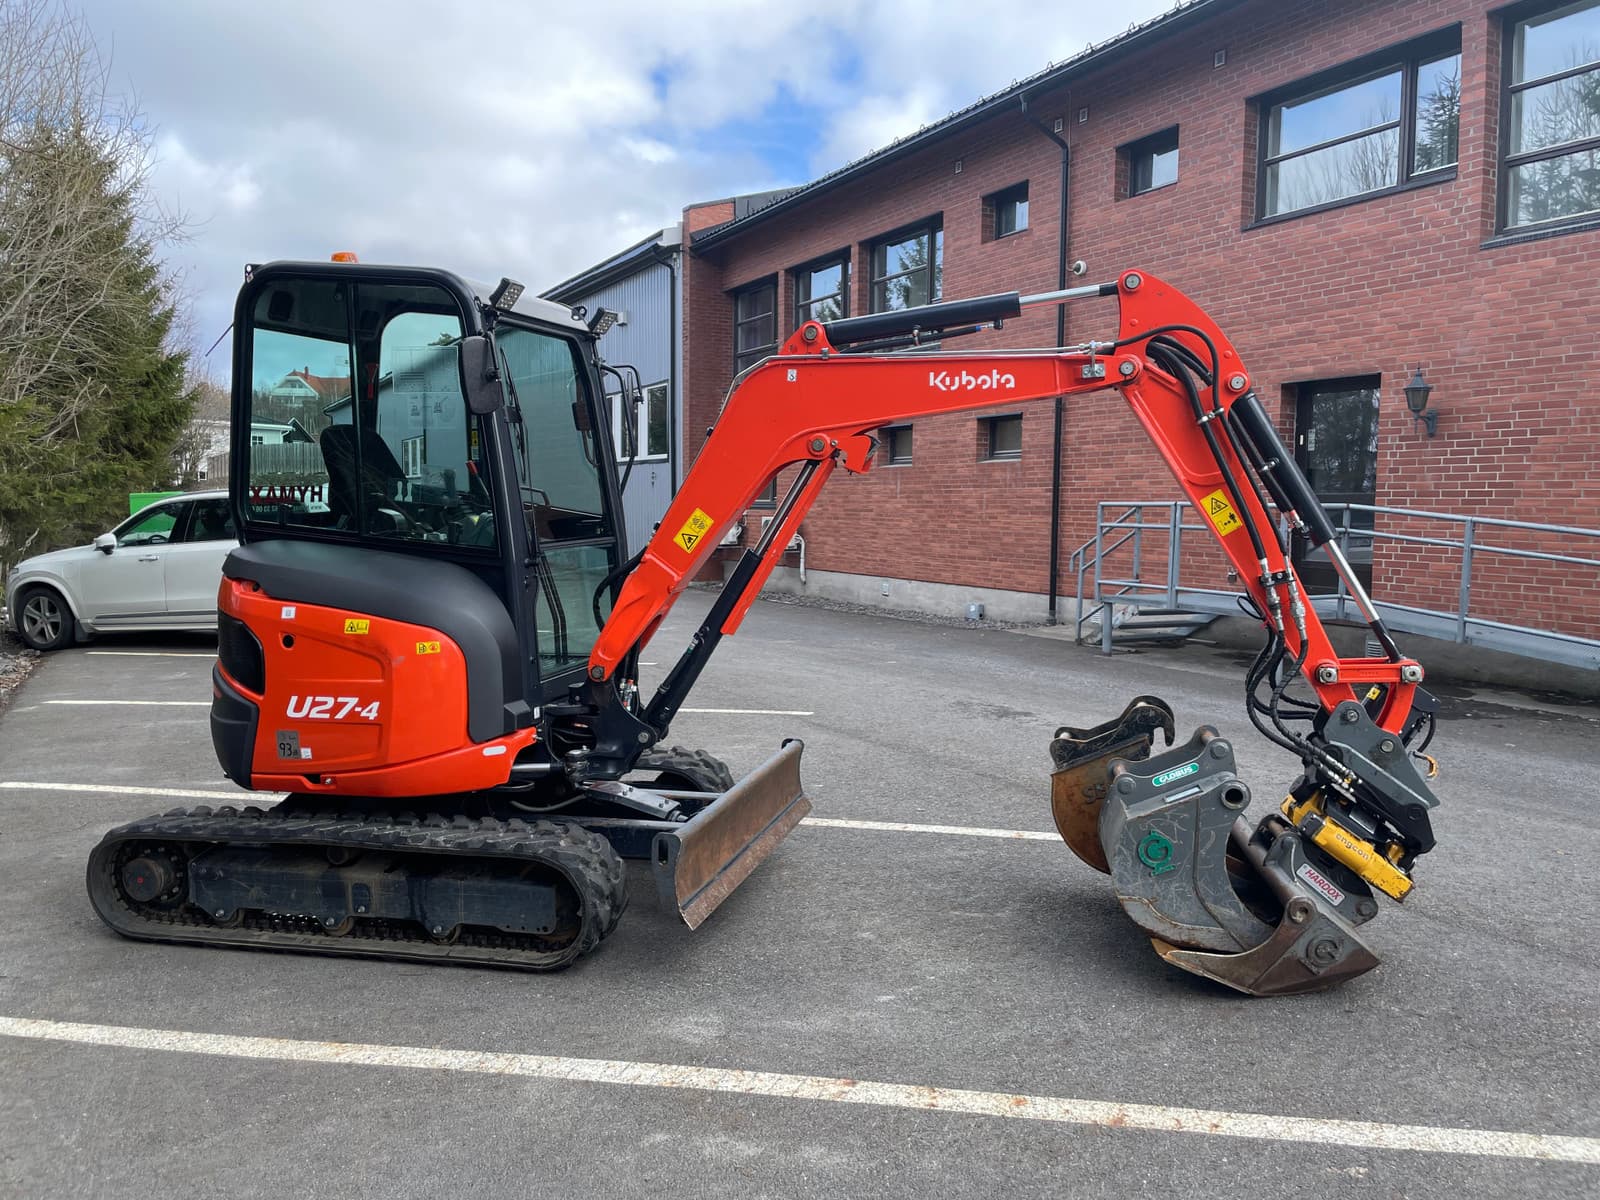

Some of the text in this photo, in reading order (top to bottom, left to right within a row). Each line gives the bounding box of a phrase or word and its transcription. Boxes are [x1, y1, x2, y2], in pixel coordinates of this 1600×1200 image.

[929, 368, 1015, 391] Kubota
[286, 695, 380, 720] U27-4
[1159, 766, 1193, 783] GLOBUS
[1335, 833, 1369, 860] engcon
[1304, 869, 1341, 900] HARDOX
